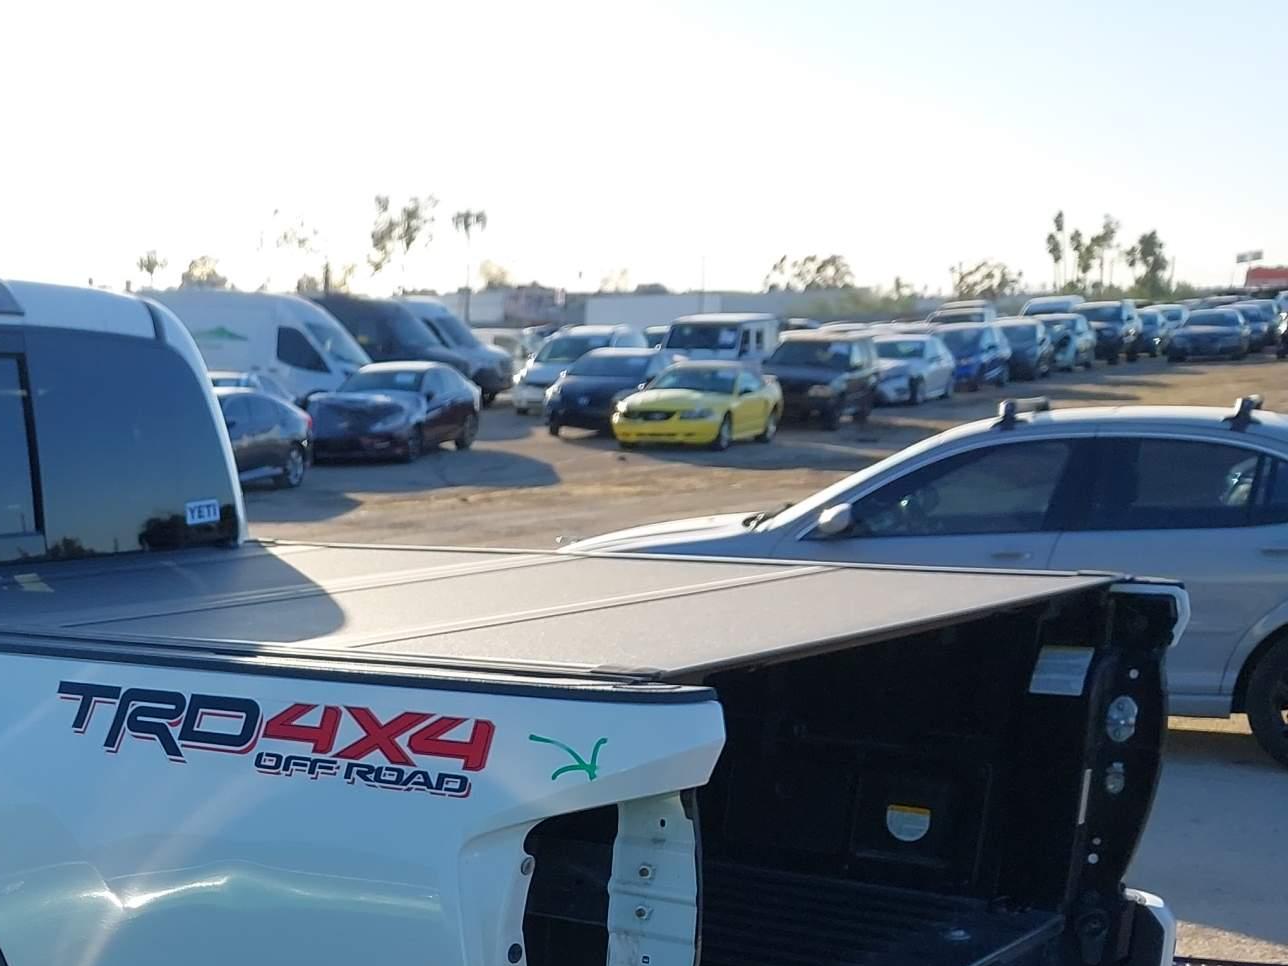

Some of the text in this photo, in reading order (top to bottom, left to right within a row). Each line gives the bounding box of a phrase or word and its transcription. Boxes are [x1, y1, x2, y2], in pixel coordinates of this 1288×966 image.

[189, 503, 218, 520] YETI
[57, 680, 496, 772] TRD 4X4
[254, 751, 472, 798] OFF ROAD
